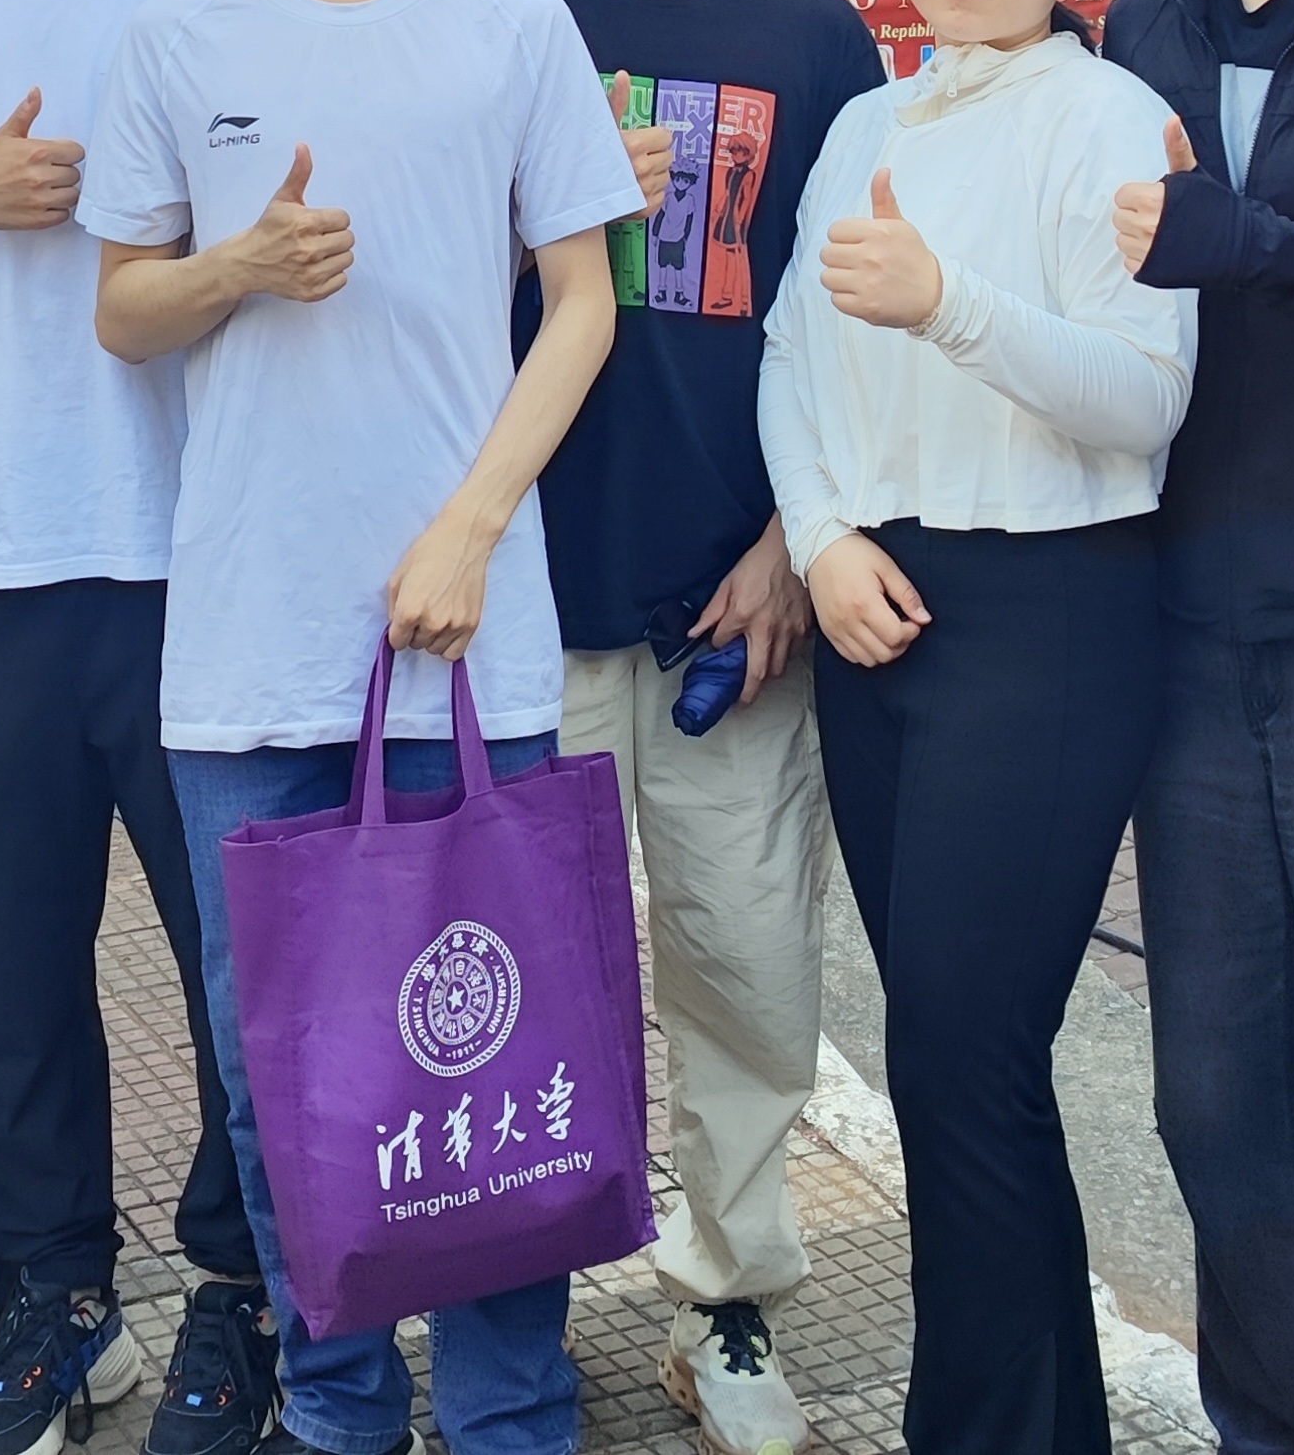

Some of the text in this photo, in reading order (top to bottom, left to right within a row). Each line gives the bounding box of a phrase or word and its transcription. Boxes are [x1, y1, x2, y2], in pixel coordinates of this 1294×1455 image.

[209, 133, 261, 148] LI-NING
[412, 996, 440, 1058] TSINGHUA
[485, 964, 507, 1035] UNIVERSITY
[380, 1149, 594, 1223] Tsinghua University
